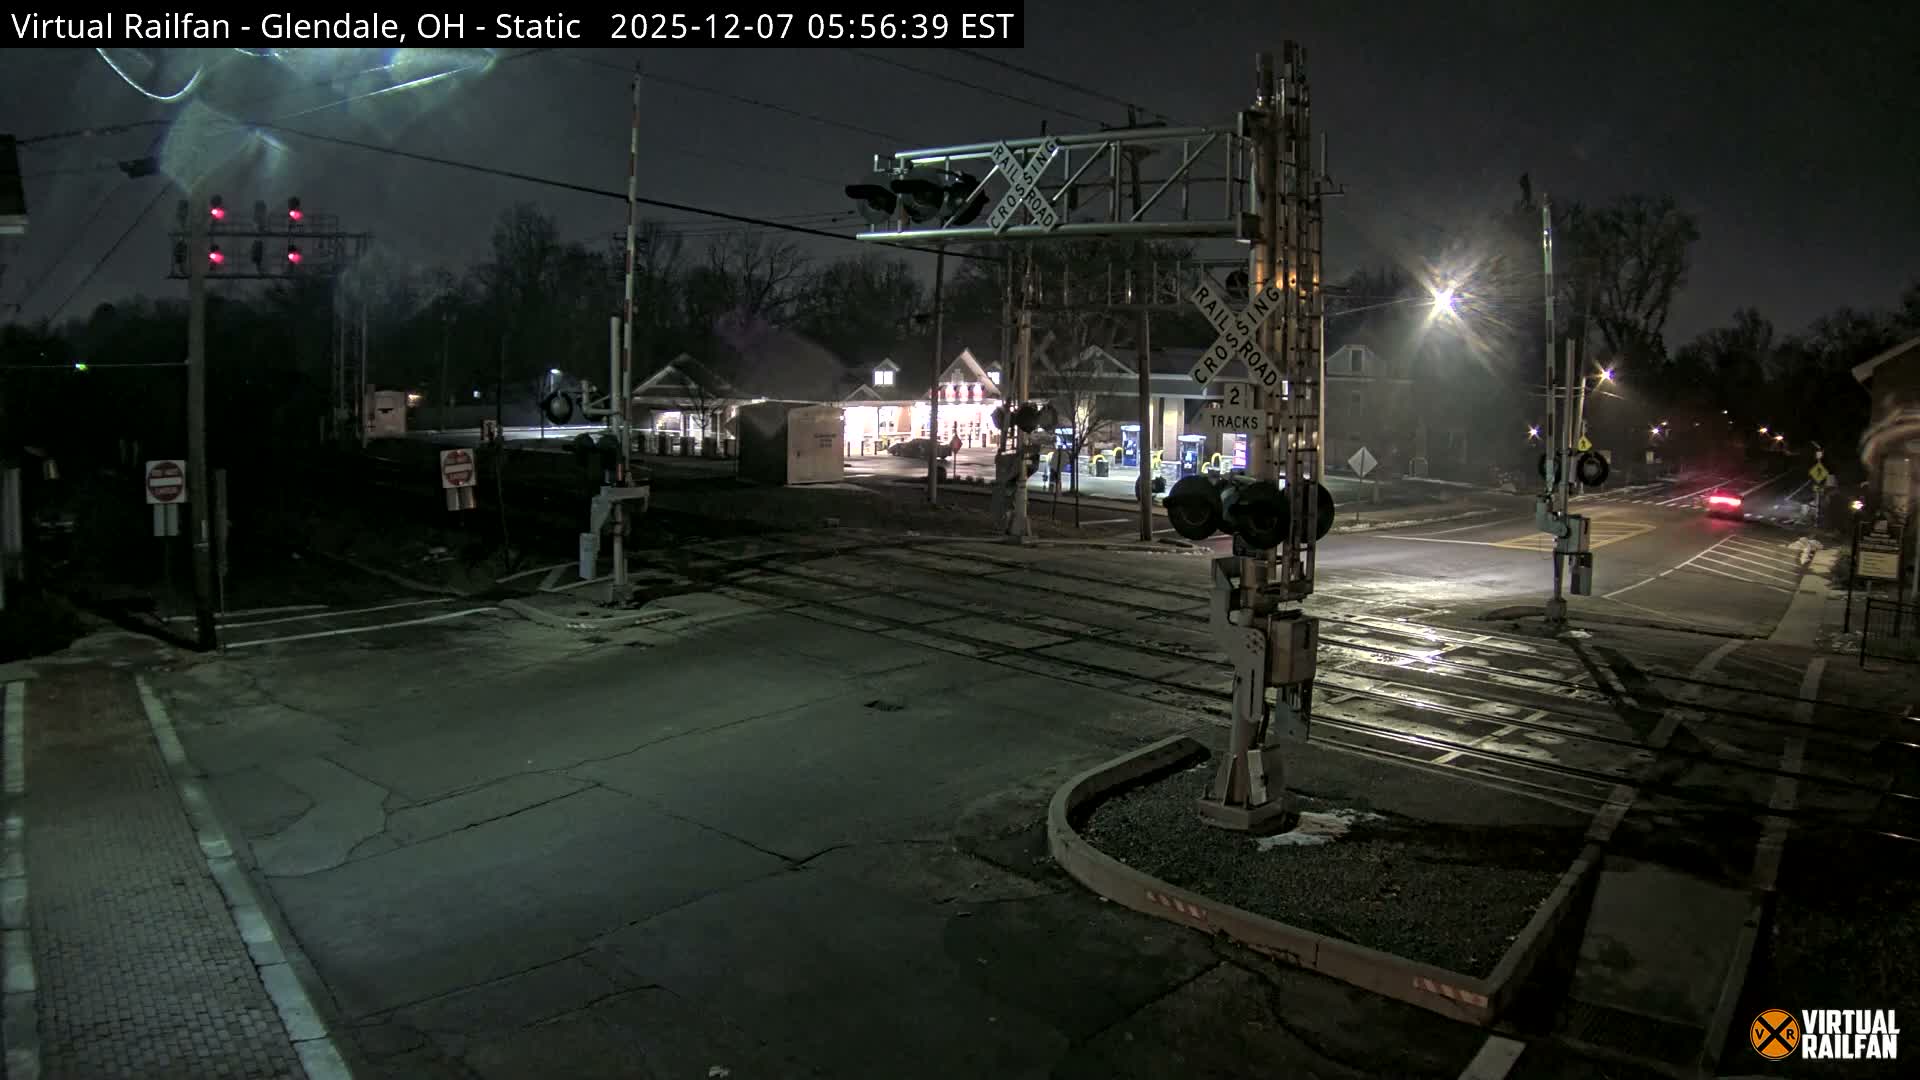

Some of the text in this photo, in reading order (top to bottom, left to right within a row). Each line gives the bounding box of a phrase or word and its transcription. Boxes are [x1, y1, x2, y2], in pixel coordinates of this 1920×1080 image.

[991, 140, 1055, 228] CROSSING
[994, 145, 1053, 227] RAILROAD
[1193, 287, 1280, 384] CROSSING
[1195, 286, 1277, 387] RAILROAD
[1210, 414, 1258, 430] TRACKS
[1229, 386, 1240, 405] 2
